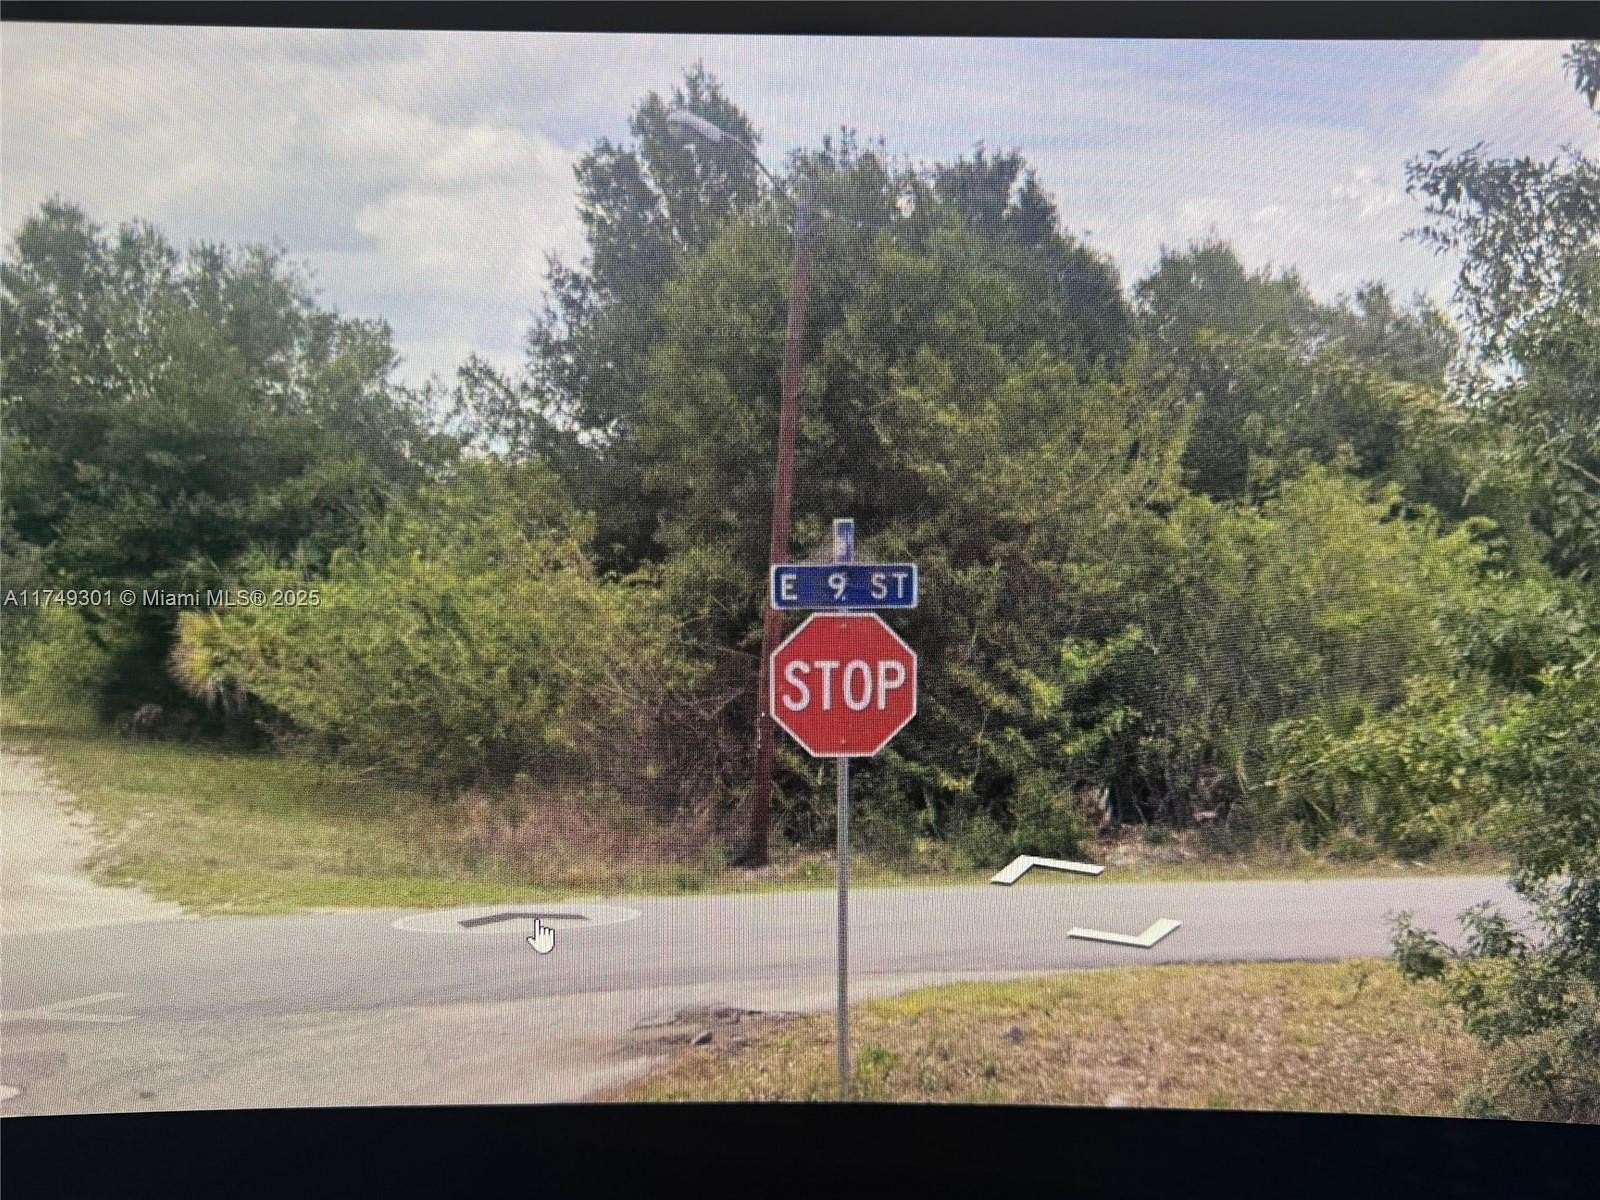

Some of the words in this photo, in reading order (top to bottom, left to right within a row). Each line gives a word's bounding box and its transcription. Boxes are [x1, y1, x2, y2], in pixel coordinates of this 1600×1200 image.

[781, 574, 798, 600] E
[828, 572, 846, 600] 9
[870, 571, 909, 599] ST
[782, 659, 907, 712] STOP
